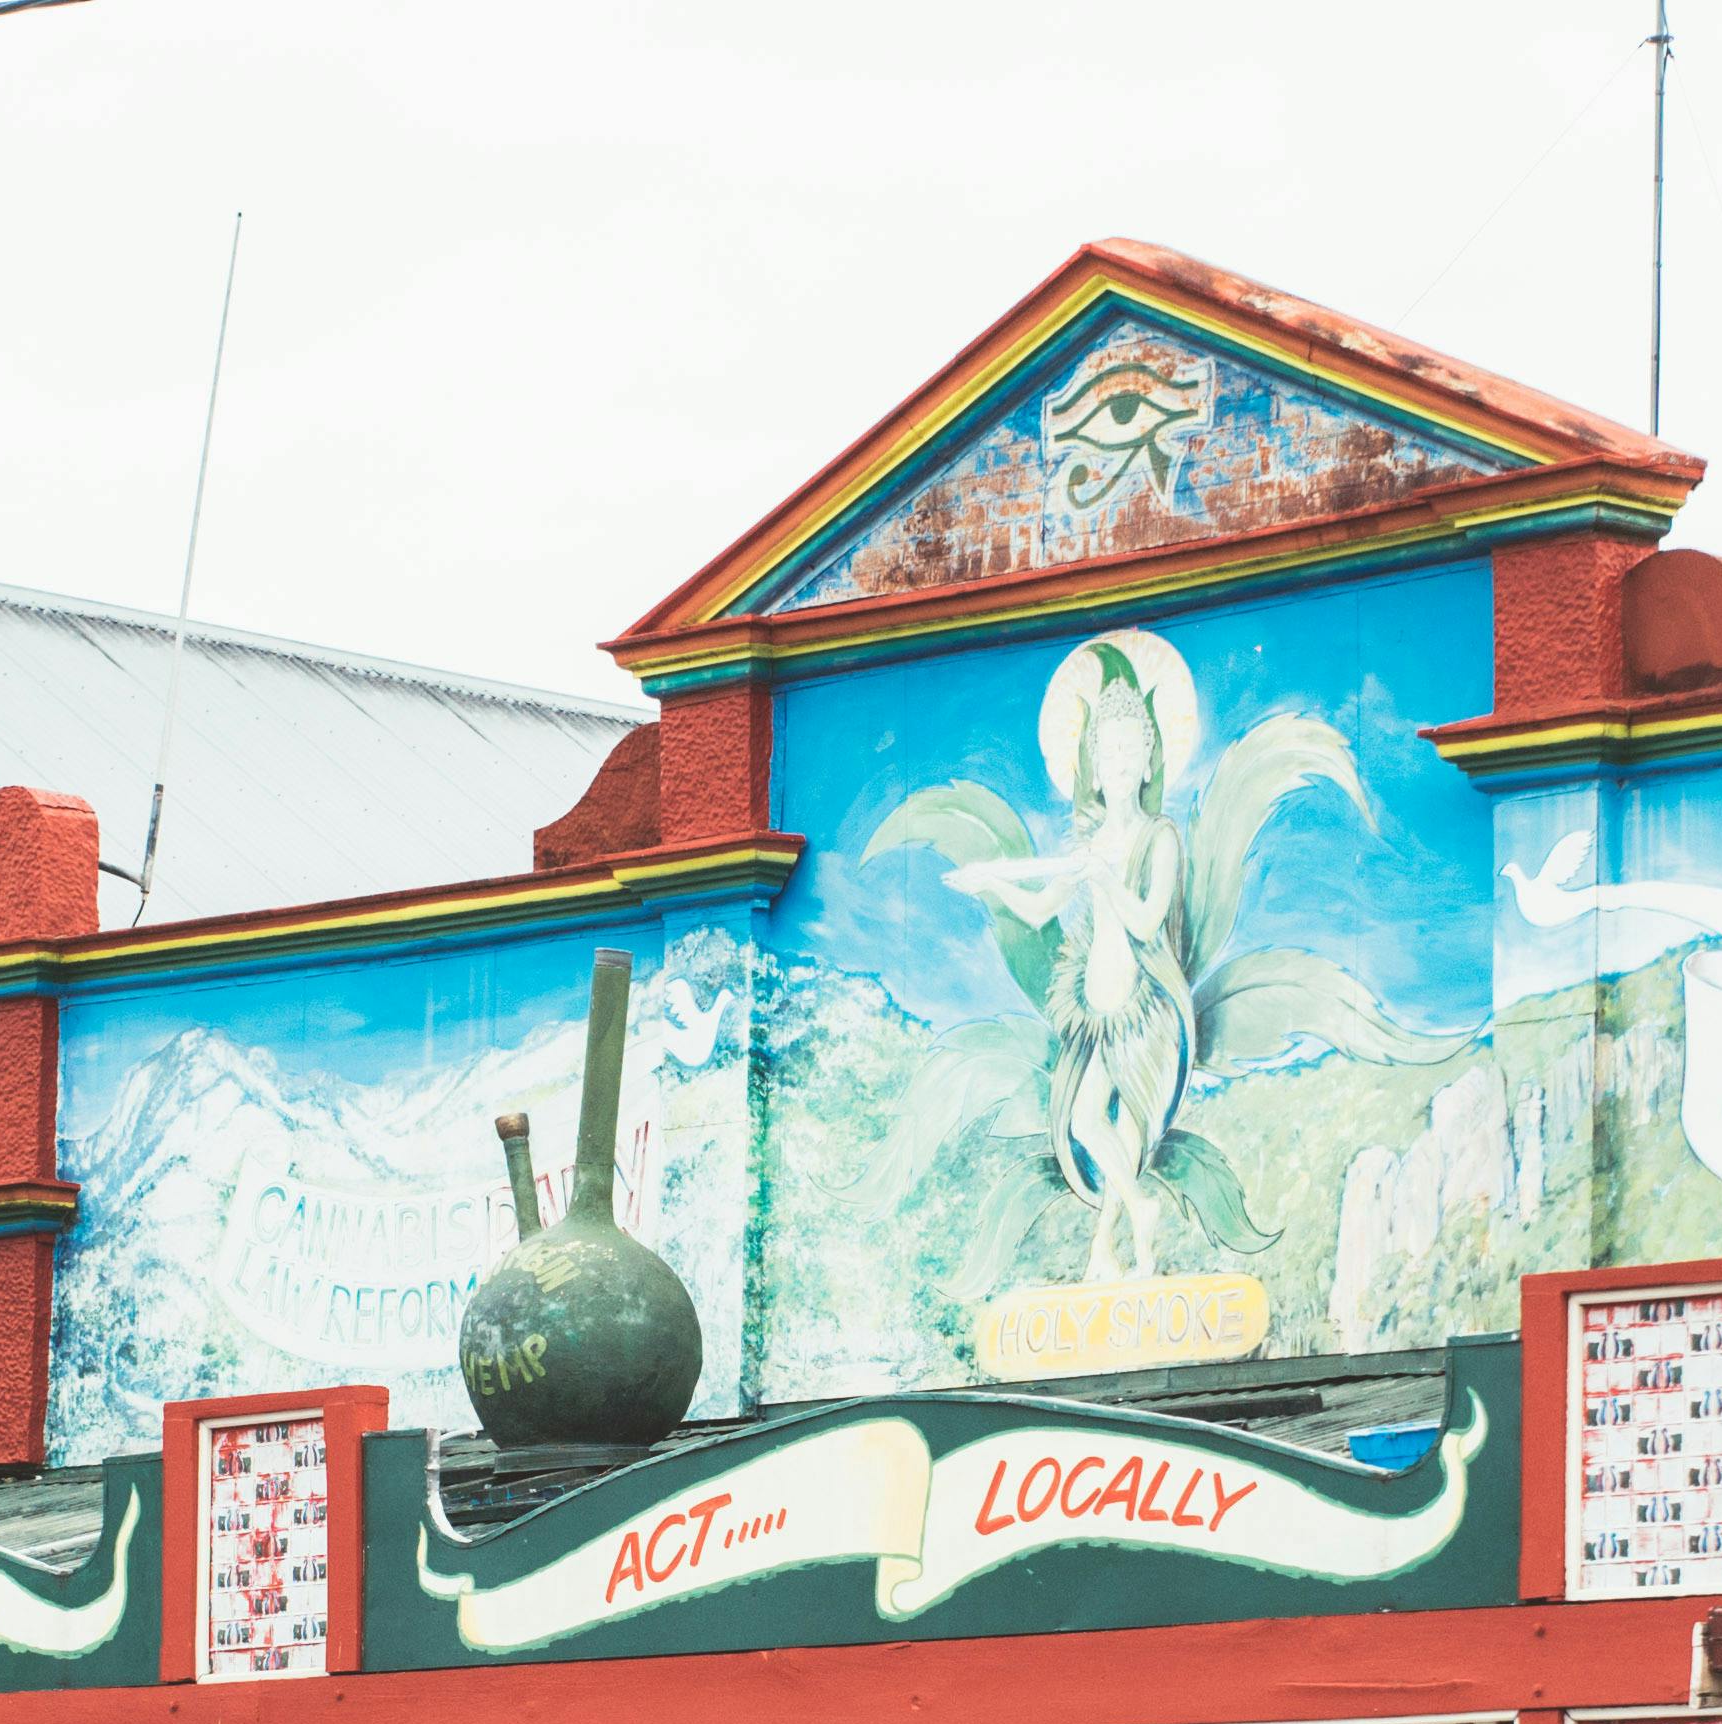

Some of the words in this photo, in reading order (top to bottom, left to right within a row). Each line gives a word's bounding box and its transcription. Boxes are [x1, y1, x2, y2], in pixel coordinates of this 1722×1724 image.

[253, 1183, 480, 1272] CANNABIS
[998, 1303, 1100, 1355] HOLY
[1108, 1289, 1245, 1349] SMOKE
[974, 1456, 1258, 1536] LOCALLY
